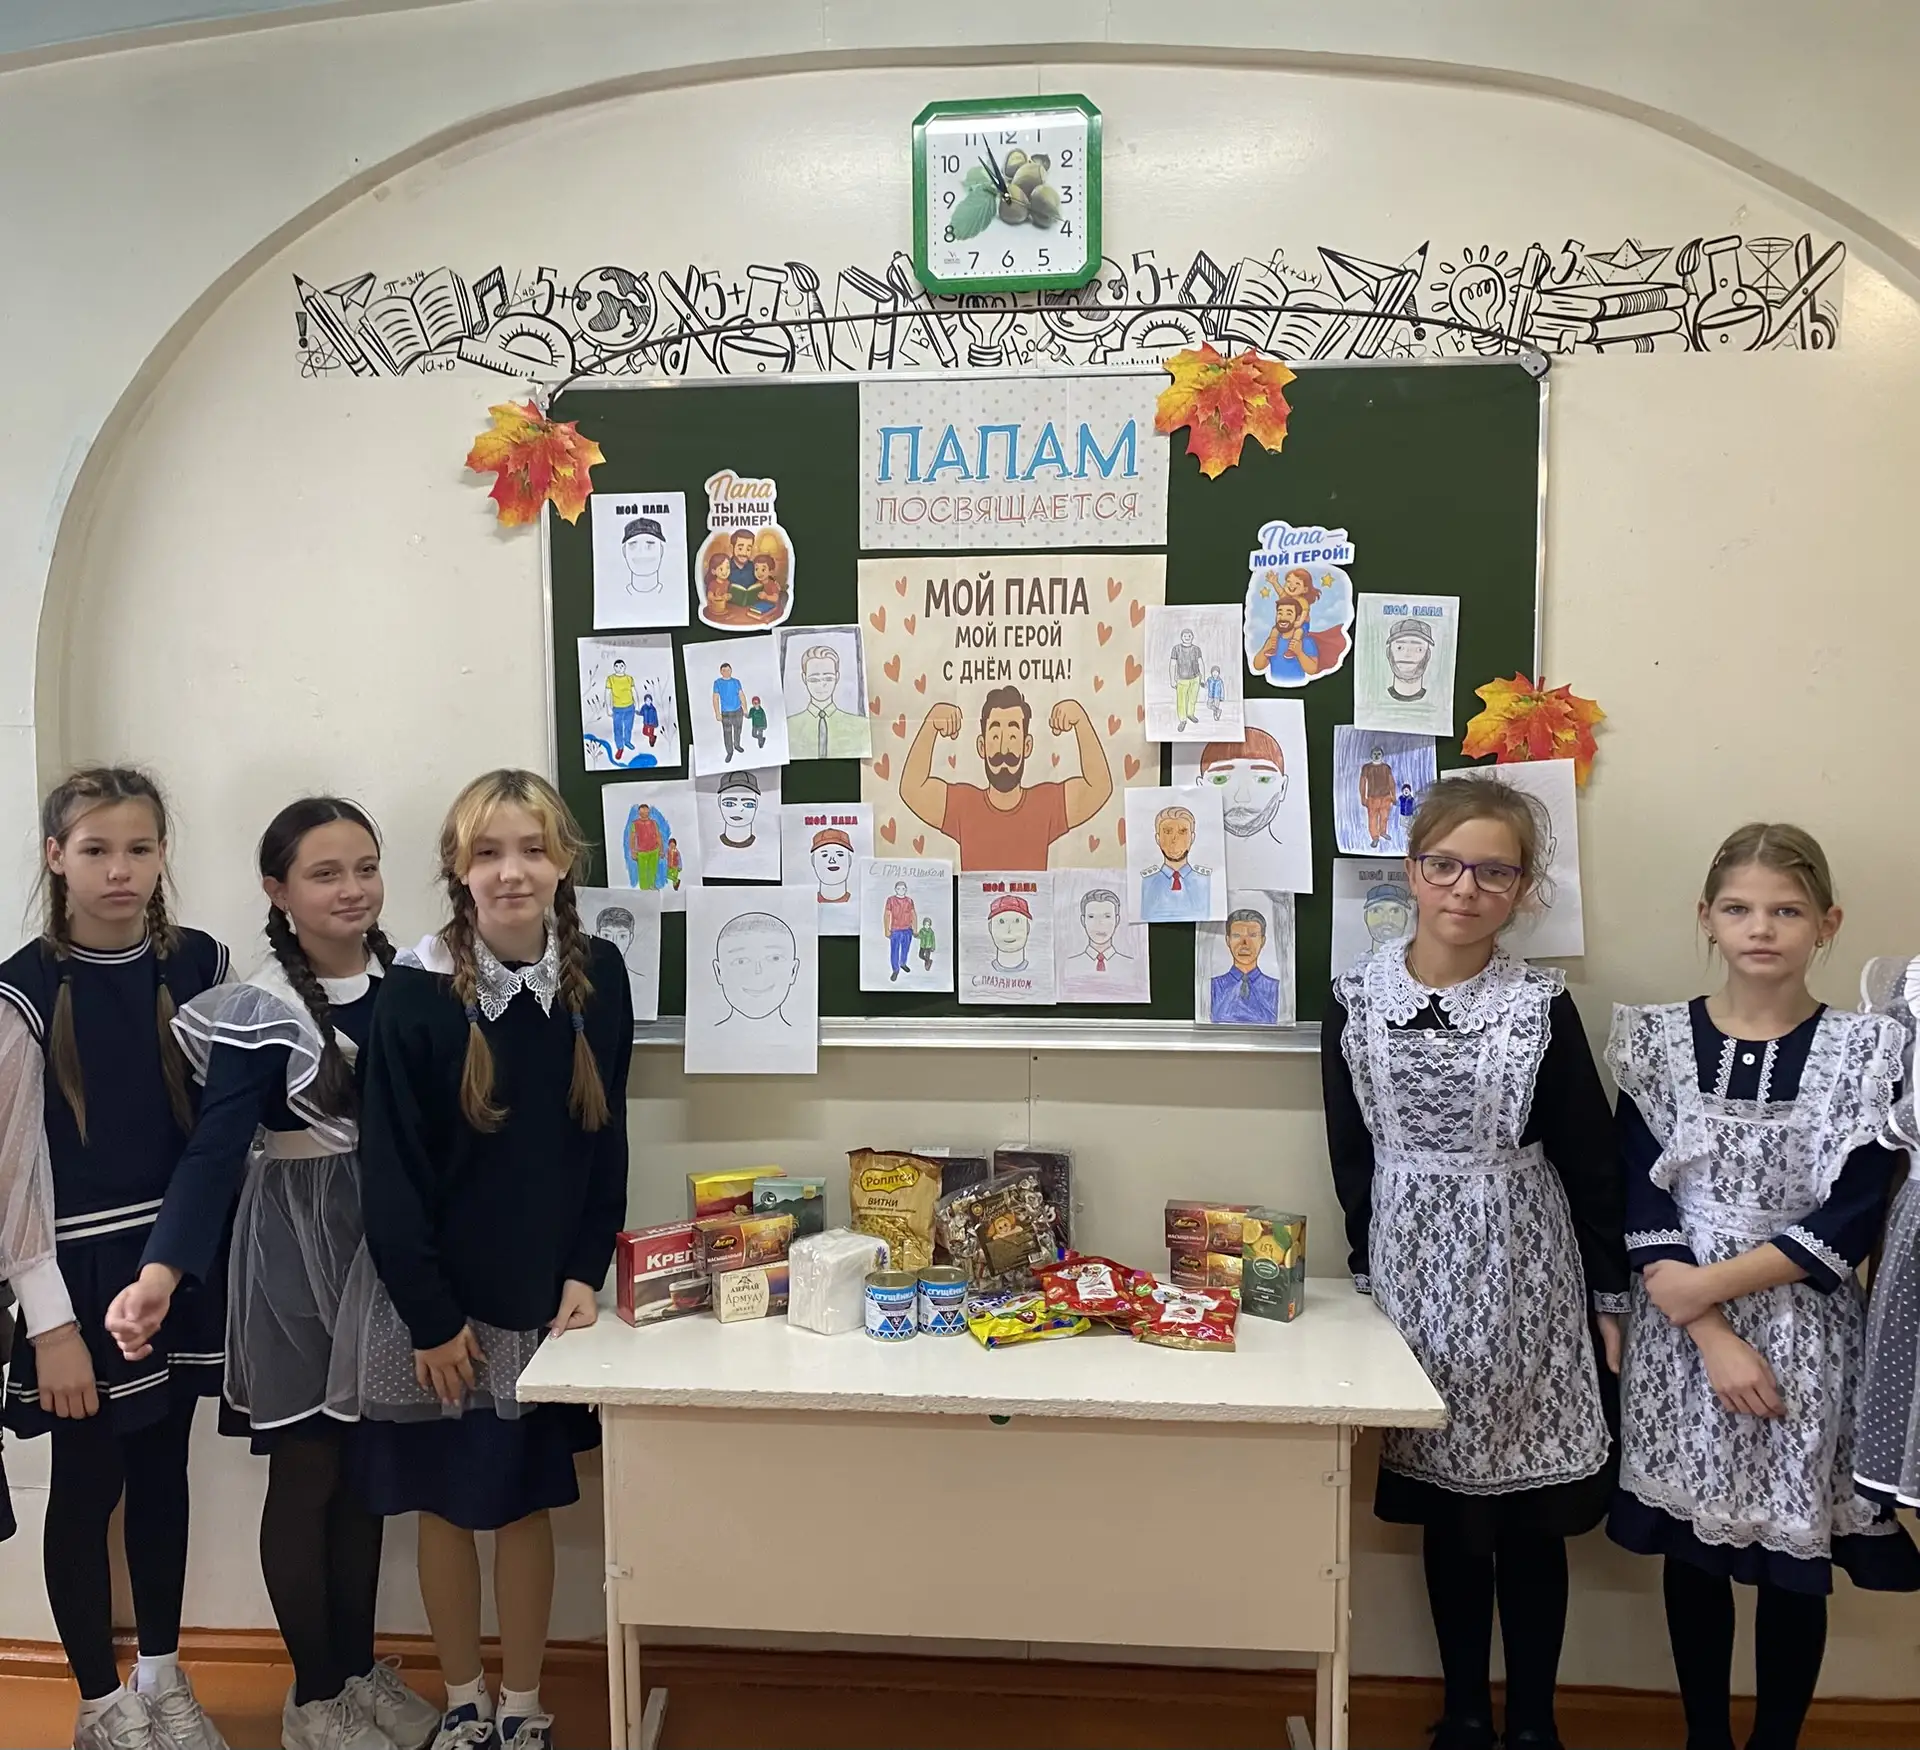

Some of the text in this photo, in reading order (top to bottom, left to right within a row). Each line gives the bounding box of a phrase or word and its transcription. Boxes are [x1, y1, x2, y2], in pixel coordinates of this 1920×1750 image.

[1000, 131, 1018, 144] 12
[941, 155, 960, 173] 10
[1061, 150, 1073, 167] 2
[943, 191, 956, 209] 9
[1061, 186, 1073, 203] 3
[944, 225, 955, 243] 8
[1060, 220, 1073, 237] 4
[968, 251, 979, 269] 7
[1002, 250, 1014, 268] 6
[1038, 249, 1049, 266] 5
[1132, 250, 1179, 305] 5+
[532, 266, 572, 316] 5+
[701, 270, 746, 320] 5+
[876, 419, 1139, 482] ПАПАМ
[709, 474, 773, 501] Папа
[615, 503, 670, 516] МОЙ ПАПА
[714, 502, 769, 514] ТЫ НАШ
[877, 491, 1140, 527] ПОСВЯЩАЕТСЯ
[711, 515, 772, 527] ПРИМЕР!
[1262, 525, 1325, 550] Папа
[1254, 543, 1350, 567] МОЙ ГЕРОЙ!
[924, 571, 1090, 618] МОЙ ПАПА
[1383, 604, 1443, 618] МОЙ ПАПА
[955, 620, 1062, 649] МОЙ ГЕРОЙ
[942, 658, 1072, 684] С ДНЁМ ОТЦА!
[804, 814, 858, 826] МОЙ ПАПА
[869, 862, 879, 876] С
[1359, 868, 1383, 881] МОЙ
[982, 881, 1037, 892] МОЙ ПАПА
[971, 975, 979, 987] С
